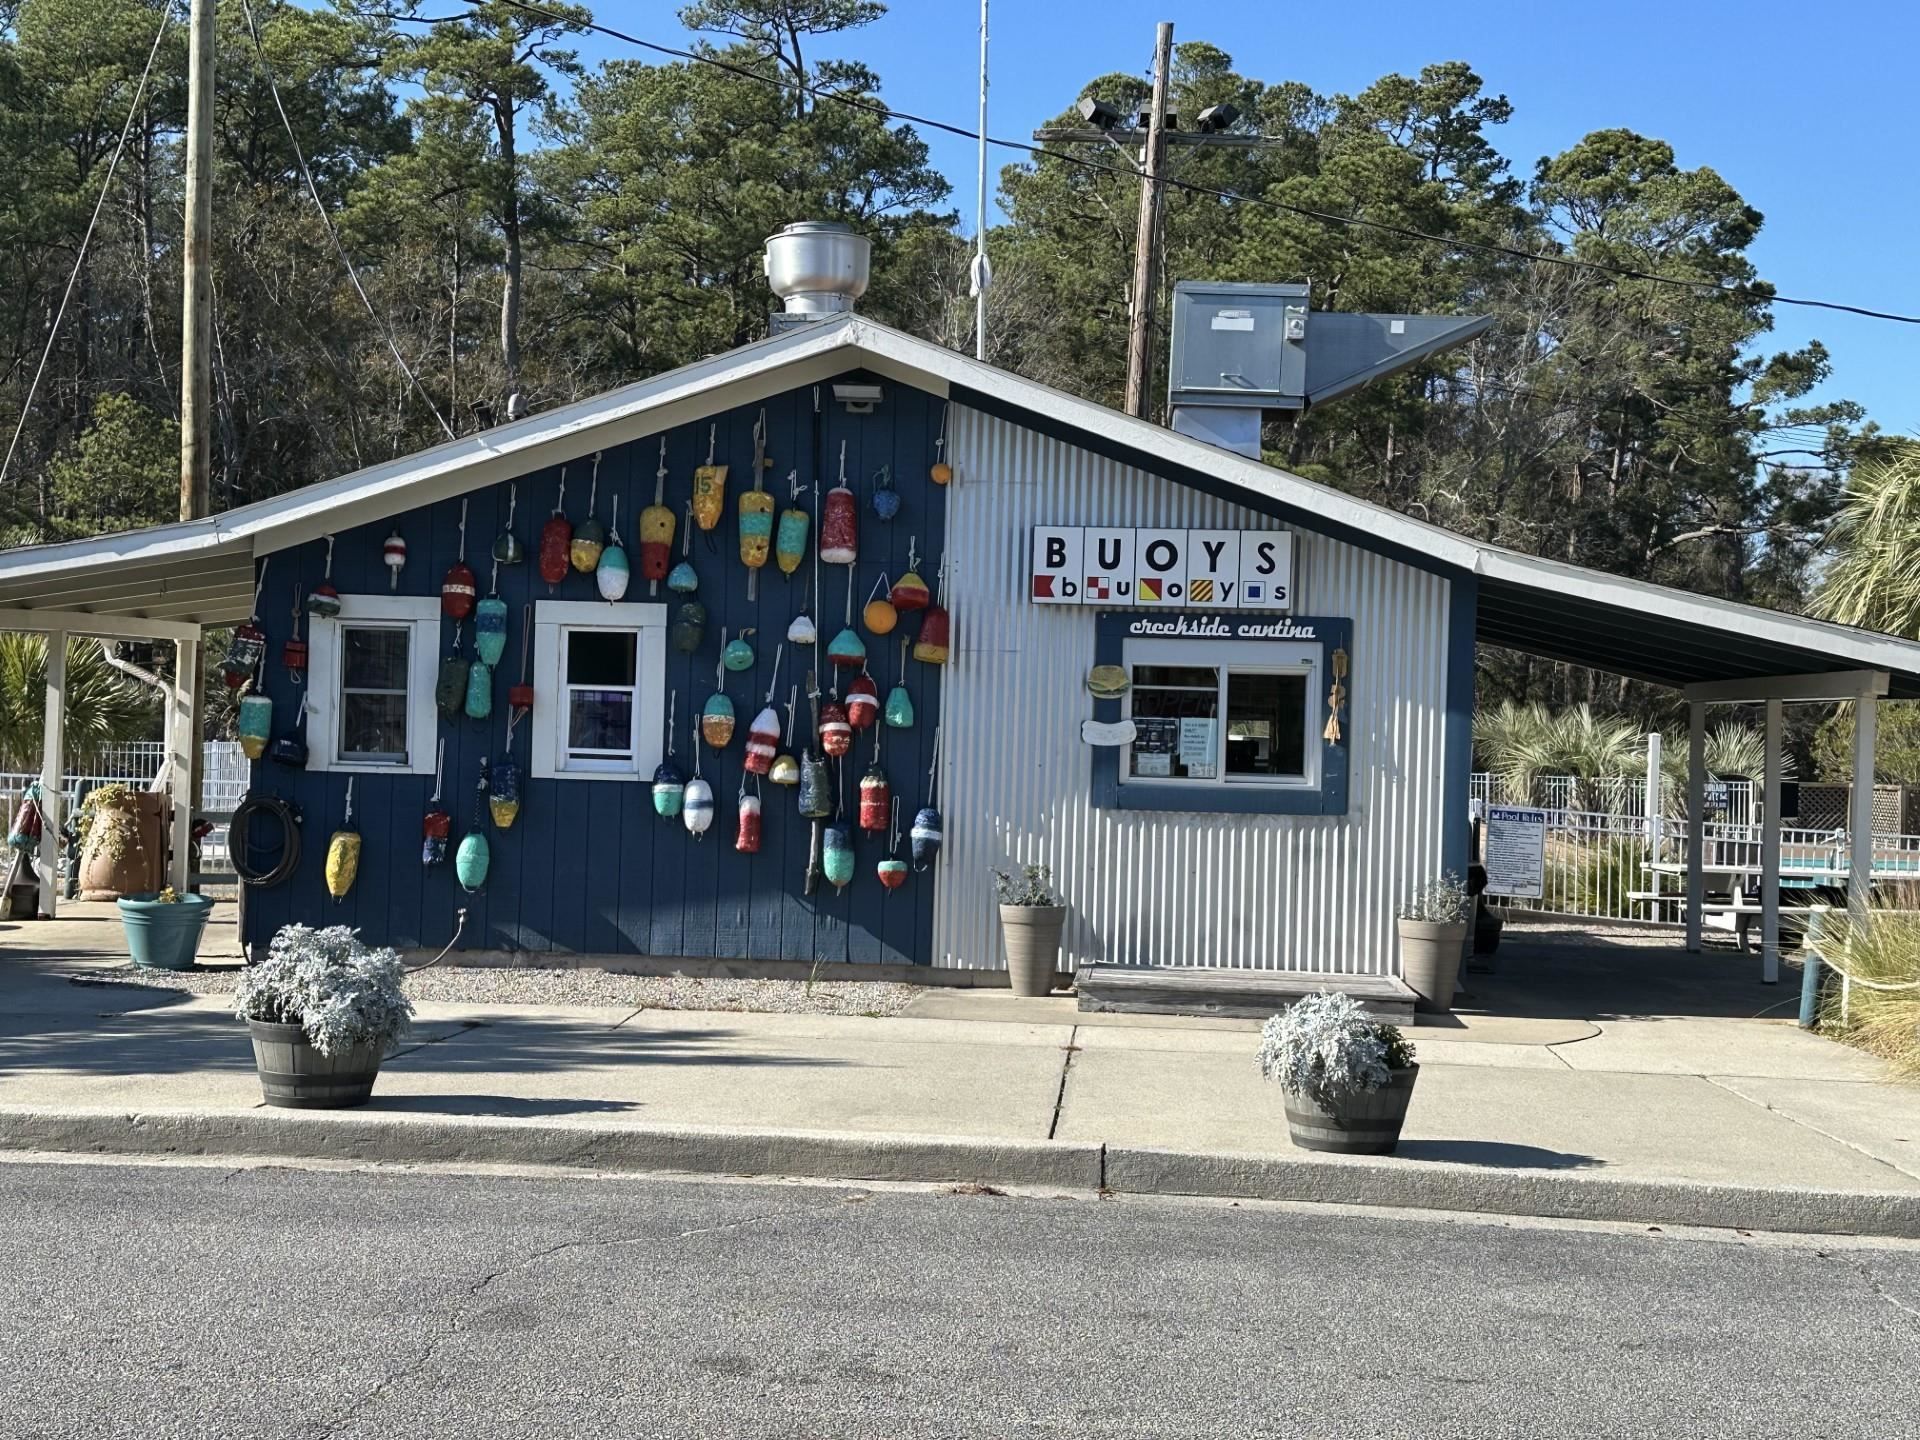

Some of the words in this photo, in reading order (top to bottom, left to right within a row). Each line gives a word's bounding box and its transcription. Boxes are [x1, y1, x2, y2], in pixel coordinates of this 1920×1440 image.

[1046, 536, 1276, 575] BUOYS
[1061, 576, 1287, 602] buoys
[1129, 615, 1232, 637] creekside
[1237, 617, 1317, 639] cantina
[1501, 811, 1520, 821] Pool
